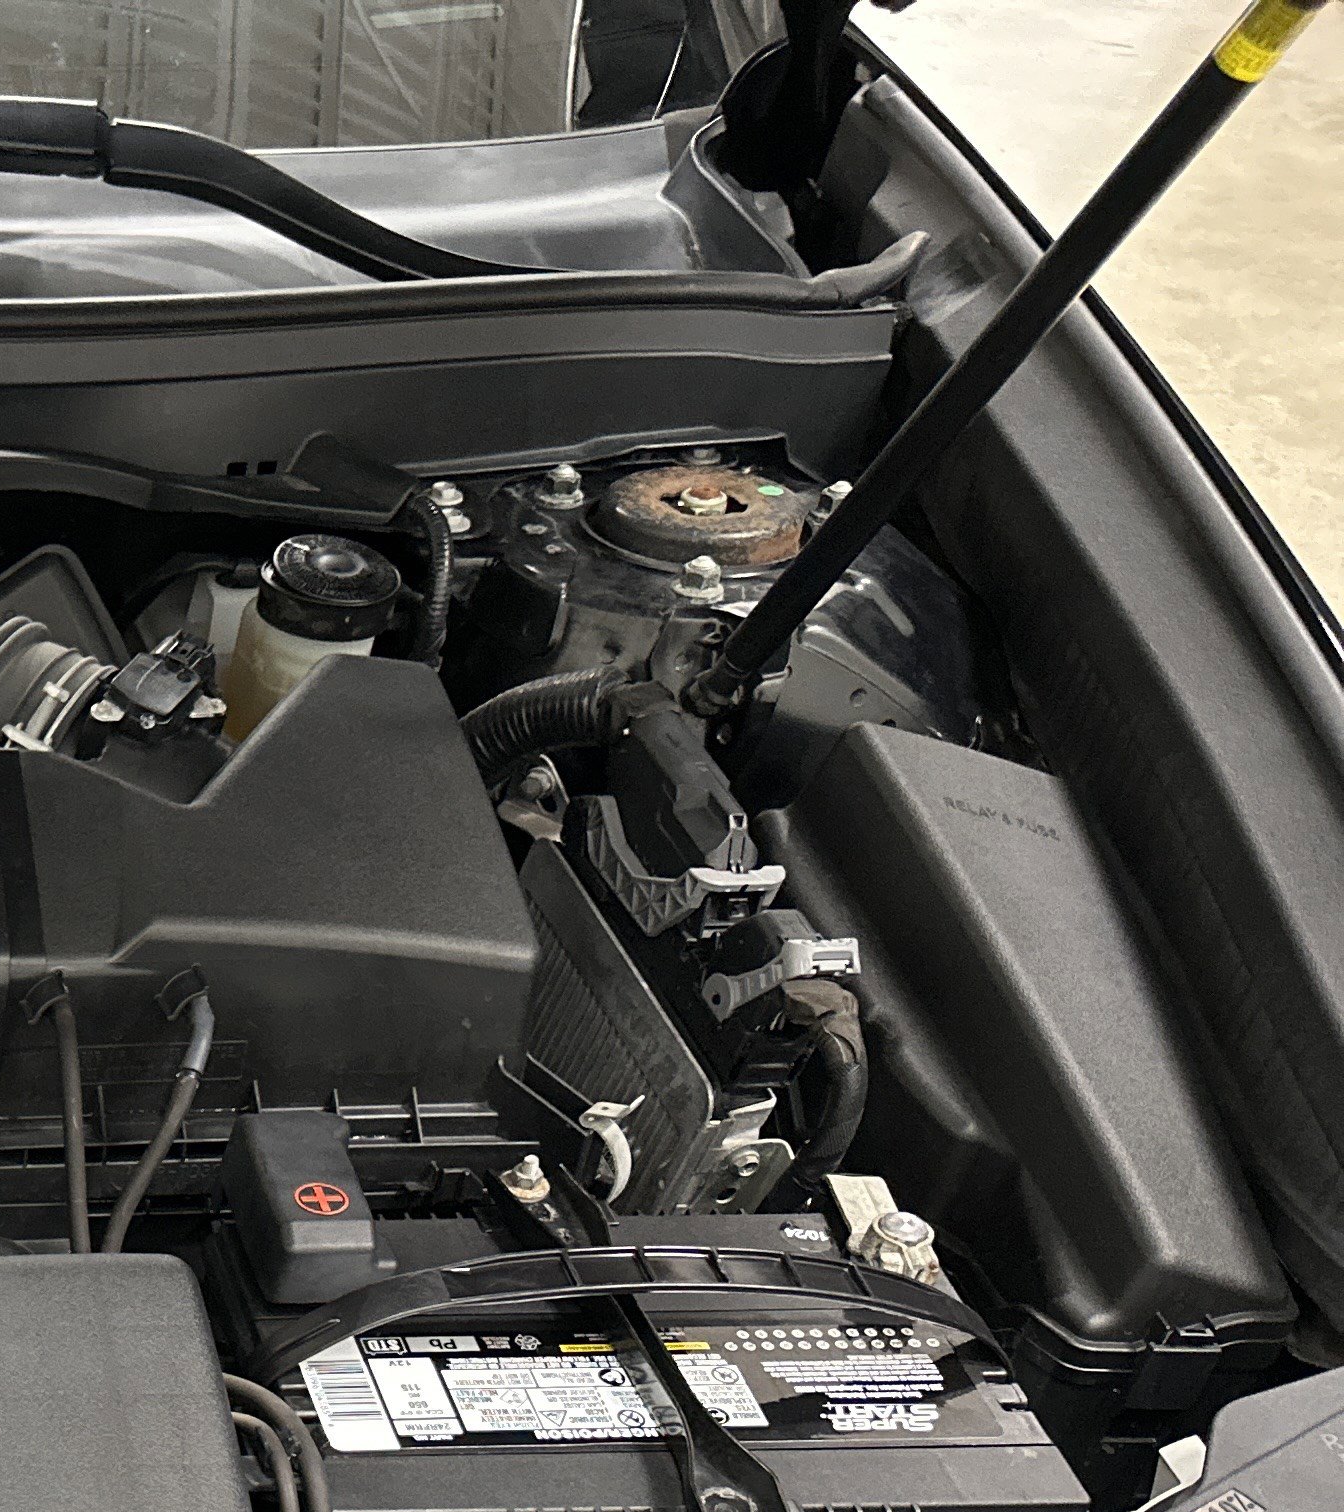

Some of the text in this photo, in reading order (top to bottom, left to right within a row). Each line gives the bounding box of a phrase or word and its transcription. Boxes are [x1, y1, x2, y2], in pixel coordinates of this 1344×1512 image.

[943, 796, 997, 821] RELAY
[366, 1339, 401, 1351] STD
[429, 1338, 457, 1349] Pb
[584, 1408, 606, 1416] ACID
[831, 1403, 938, 1418] START
[831, 1416, 934, 1431] SUPER
[534, 1427, 659, 1440] NGER/POISON
